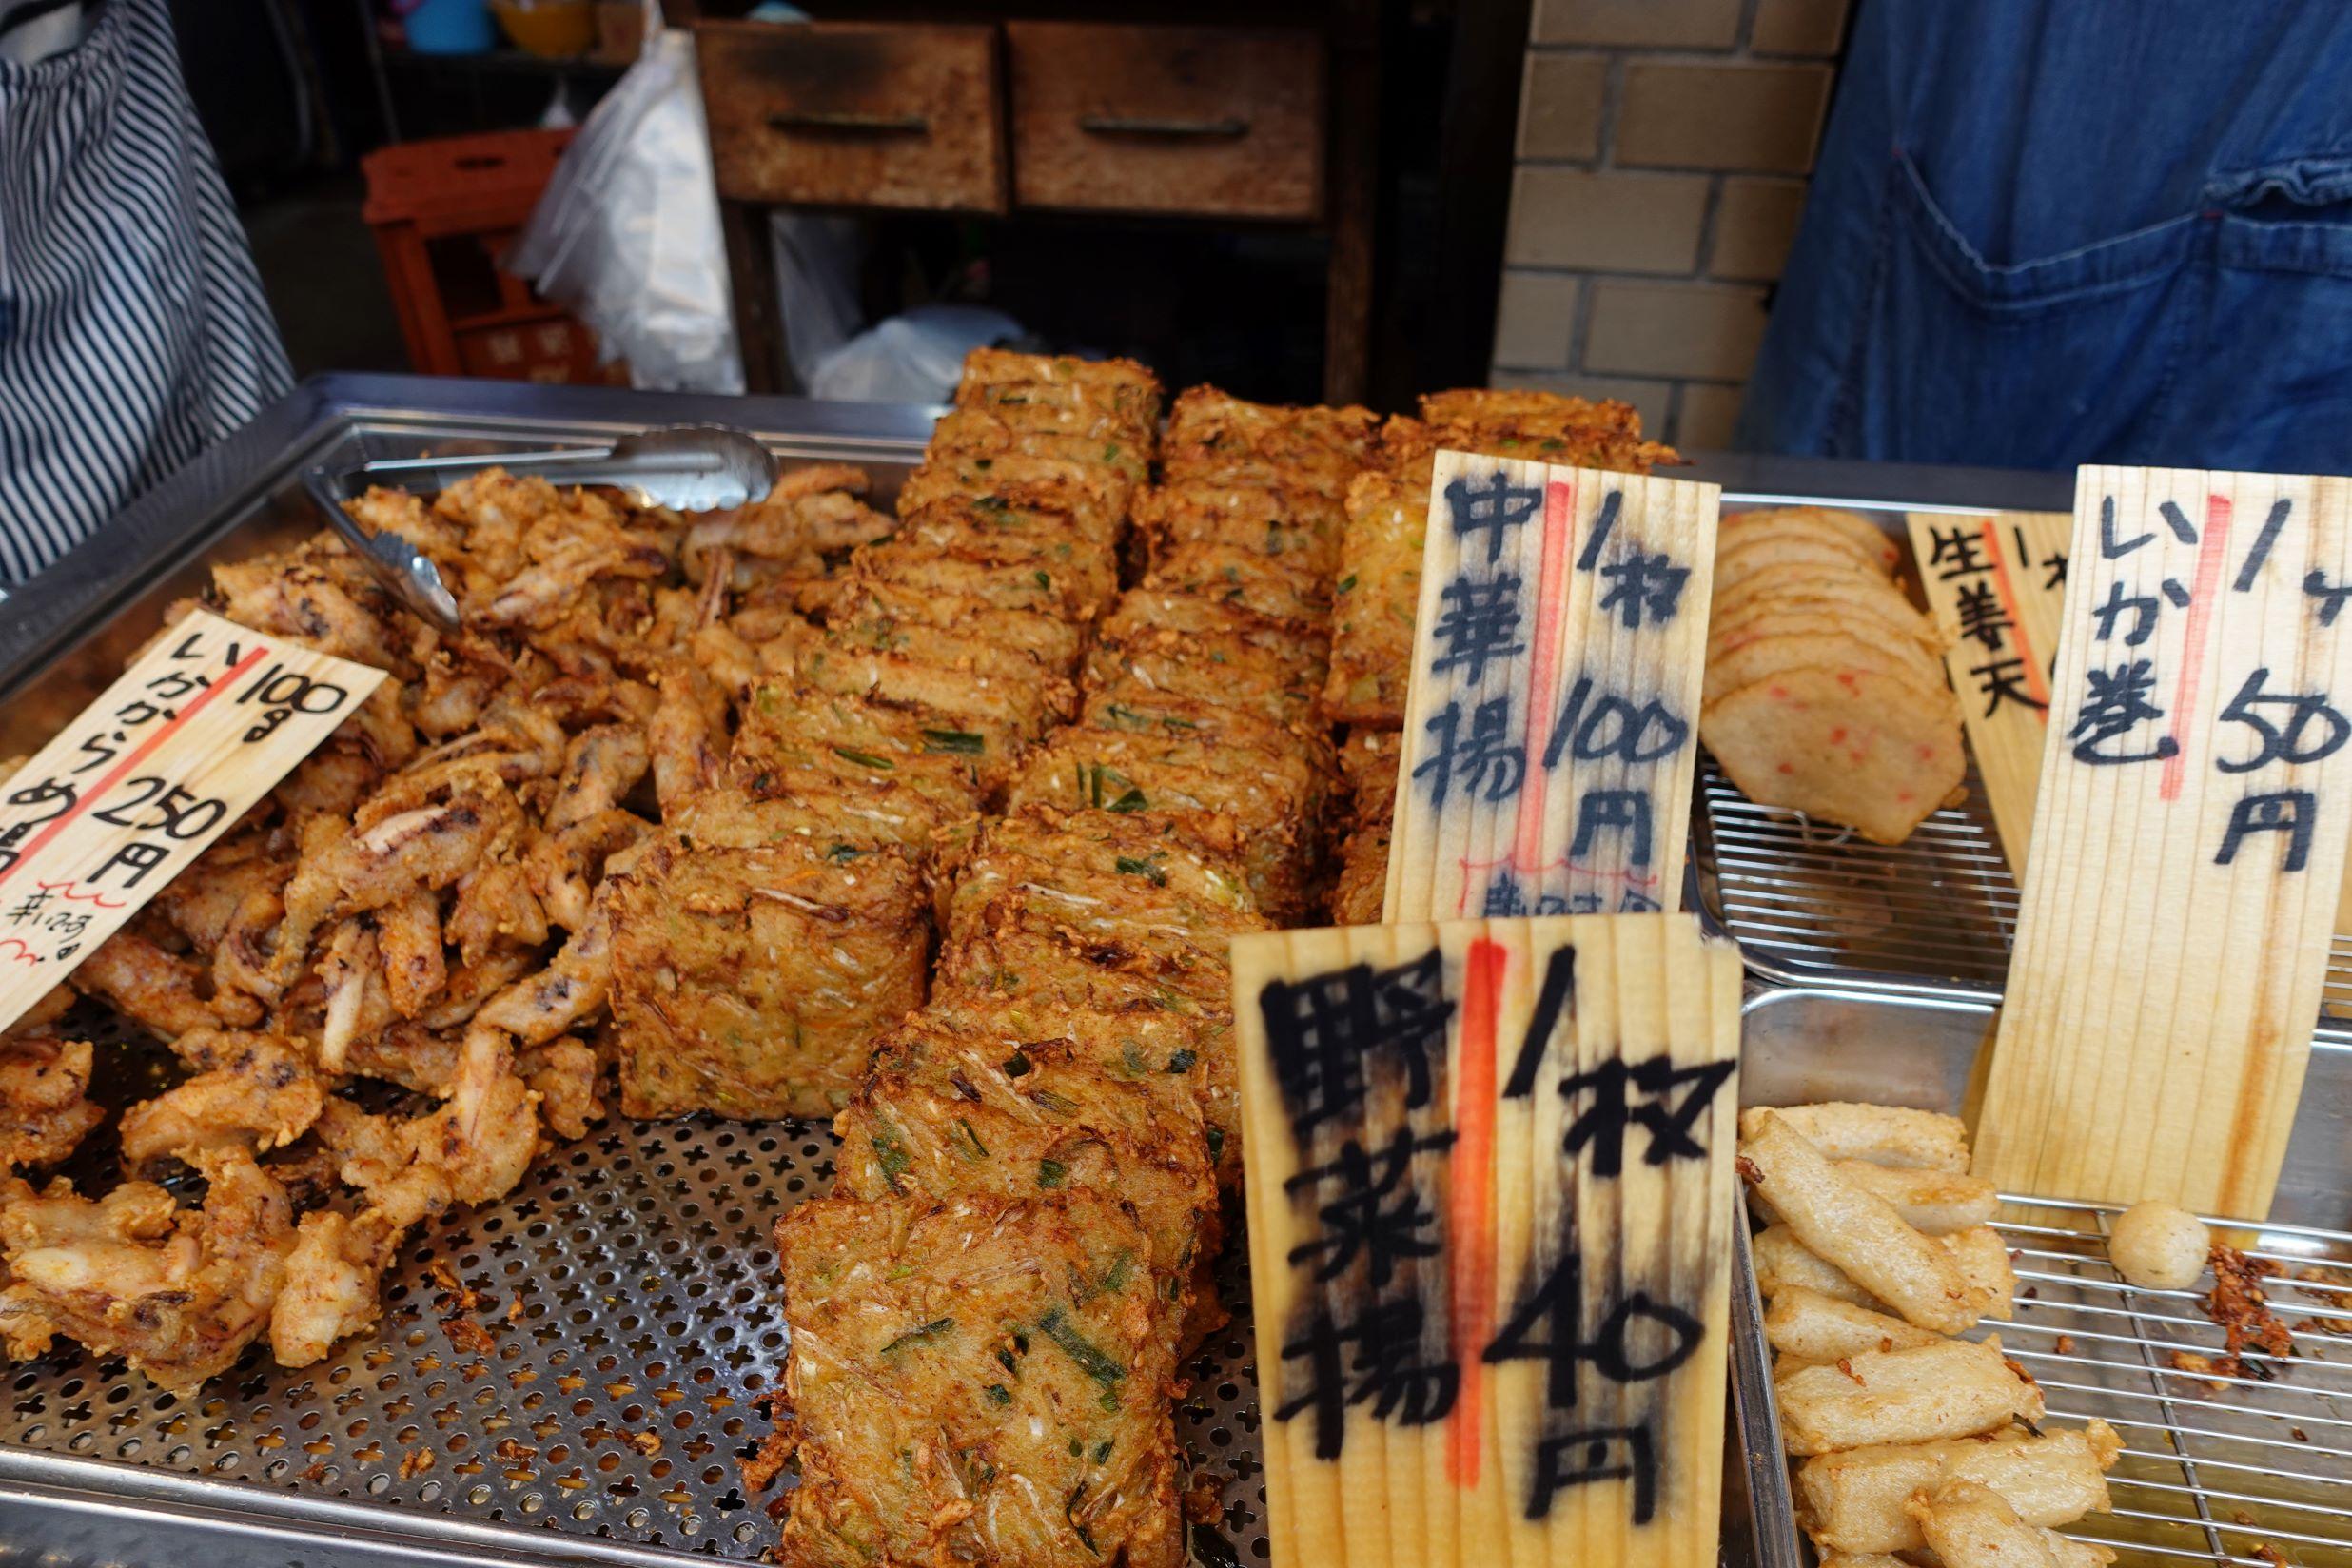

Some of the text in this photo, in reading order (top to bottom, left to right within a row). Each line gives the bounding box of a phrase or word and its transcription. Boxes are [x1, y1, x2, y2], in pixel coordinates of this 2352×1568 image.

[1413, 470, 1543, 808] 中華揚
[2068, 495, 2198, 765] いか巻
[87, 776, 227, 889] 250円
[1542, 677, 1689, 865] 100円
[2213, 668, 2352, 872] 50円
[1259, 944, 1460, 1460] 野菜揚
[1480, 1253, 1706, 1525] 40円
